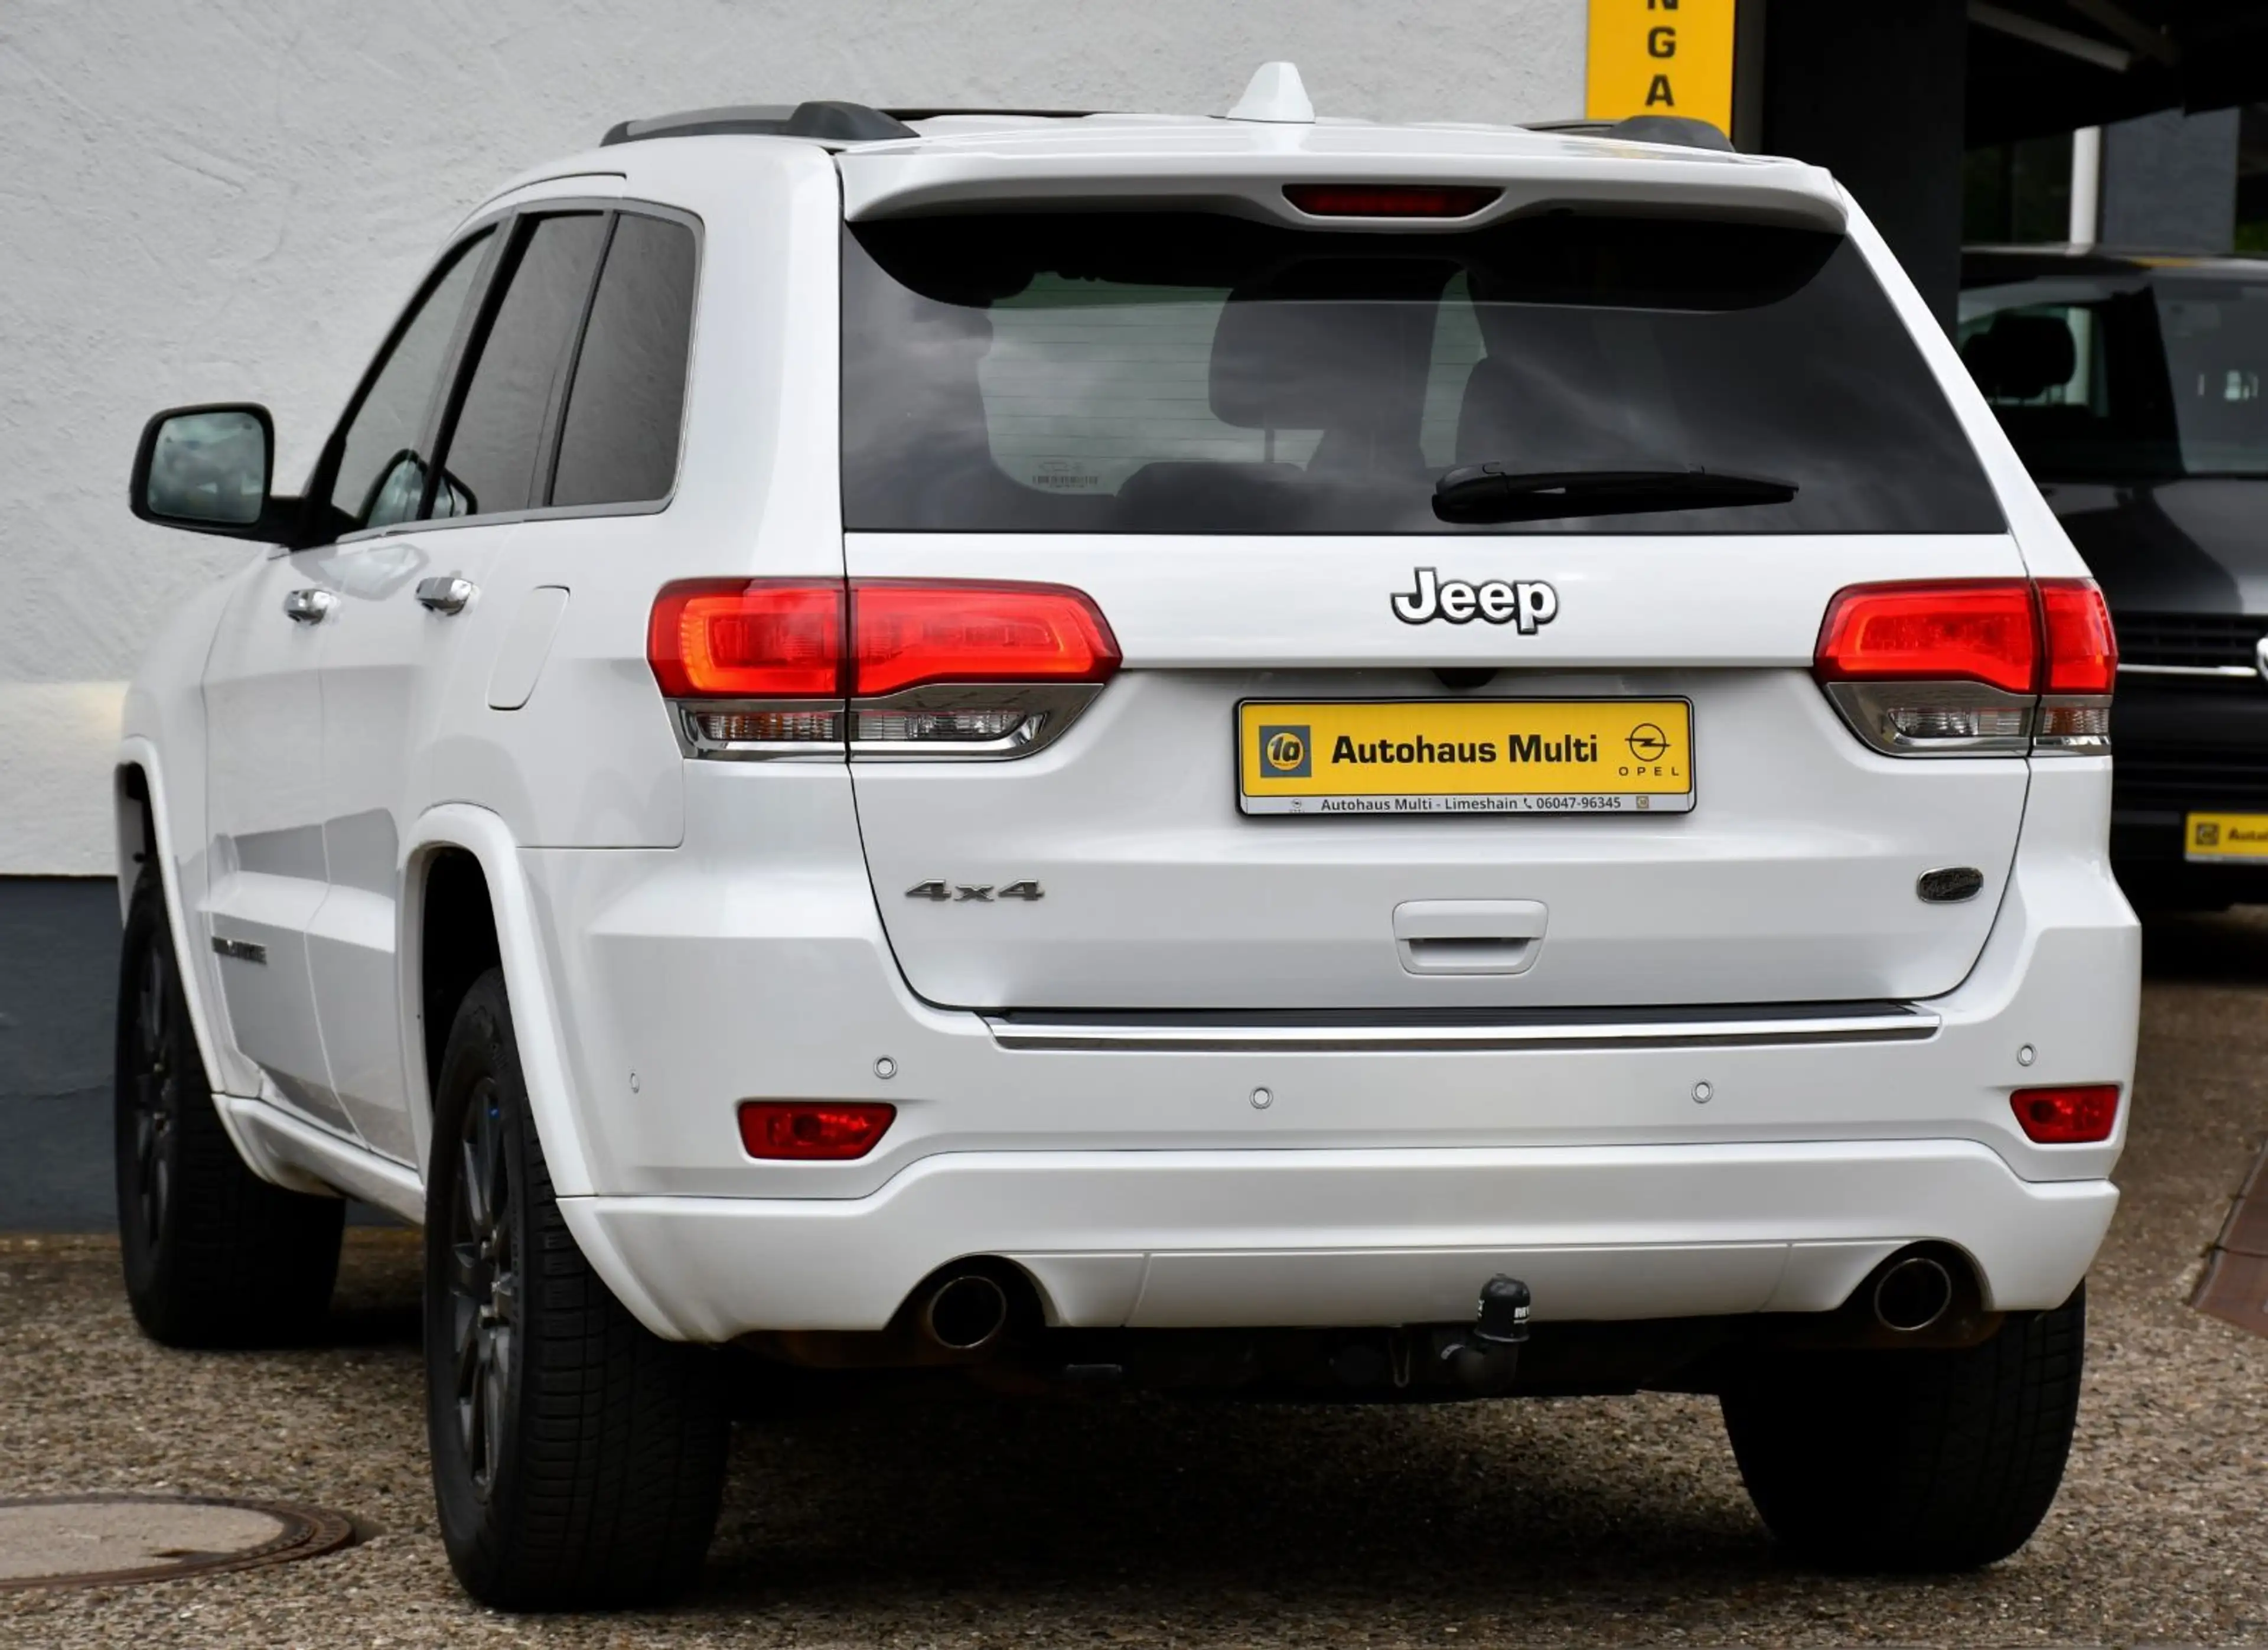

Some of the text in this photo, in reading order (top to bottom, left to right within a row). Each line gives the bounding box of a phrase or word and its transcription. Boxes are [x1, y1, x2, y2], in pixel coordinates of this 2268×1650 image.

[1390, 567, 1559, 635] Jeep
[1331, 734, 1598, 764] Autohaus Multi
[1618, 766, 1680, 776] OPEL
[1321, 798, 1390, 811] Autohaus
[1394, 797, 1432, 811] Multi
[1445, 797, 1518, 810] Limeshain
[1536, 796, 1621, 809] 06047-96345
[904, 878, 1045, 902] 4x4
